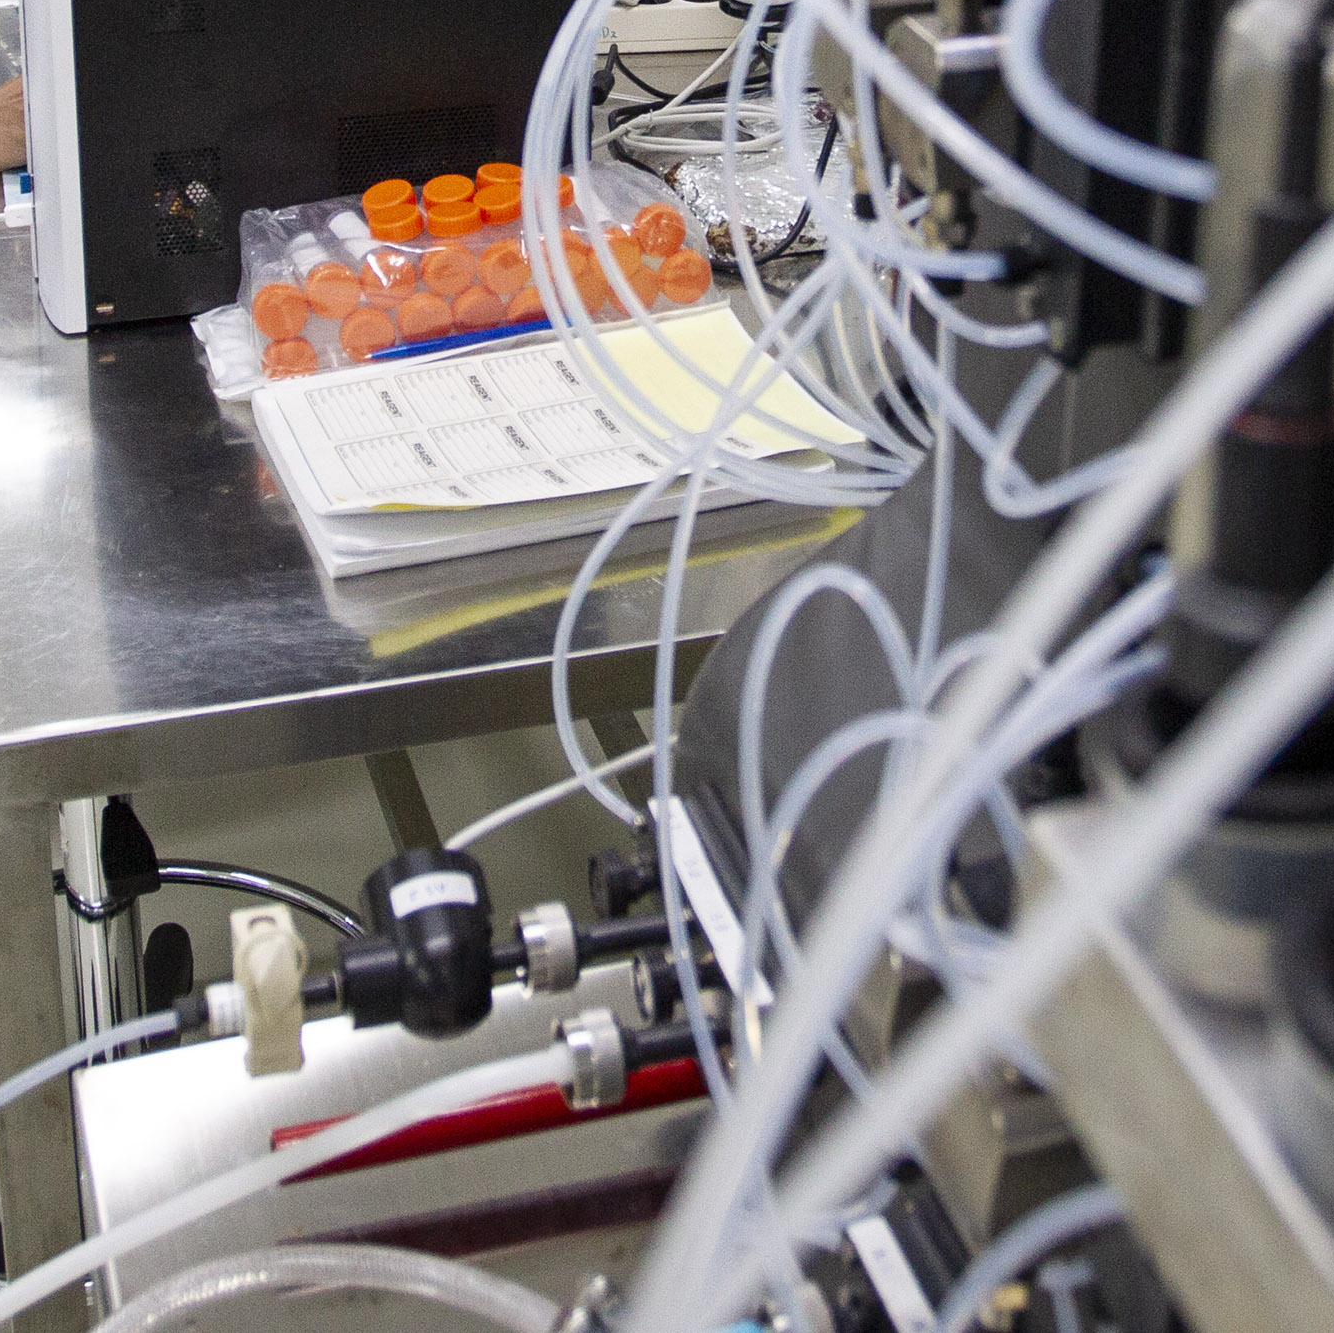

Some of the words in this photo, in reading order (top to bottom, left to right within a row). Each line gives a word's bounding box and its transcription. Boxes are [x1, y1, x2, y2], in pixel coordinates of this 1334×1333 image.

[554, 360, 580, 387] REAGENT
[468, 375, 492, 402] REAGENT
[379, 390, 402, 418] REAGENT
[594, 408, 621, 434] REAGENT
[505, 425, 529, 451] REAGENT
[413, 442, 437, 468] REAGENT
